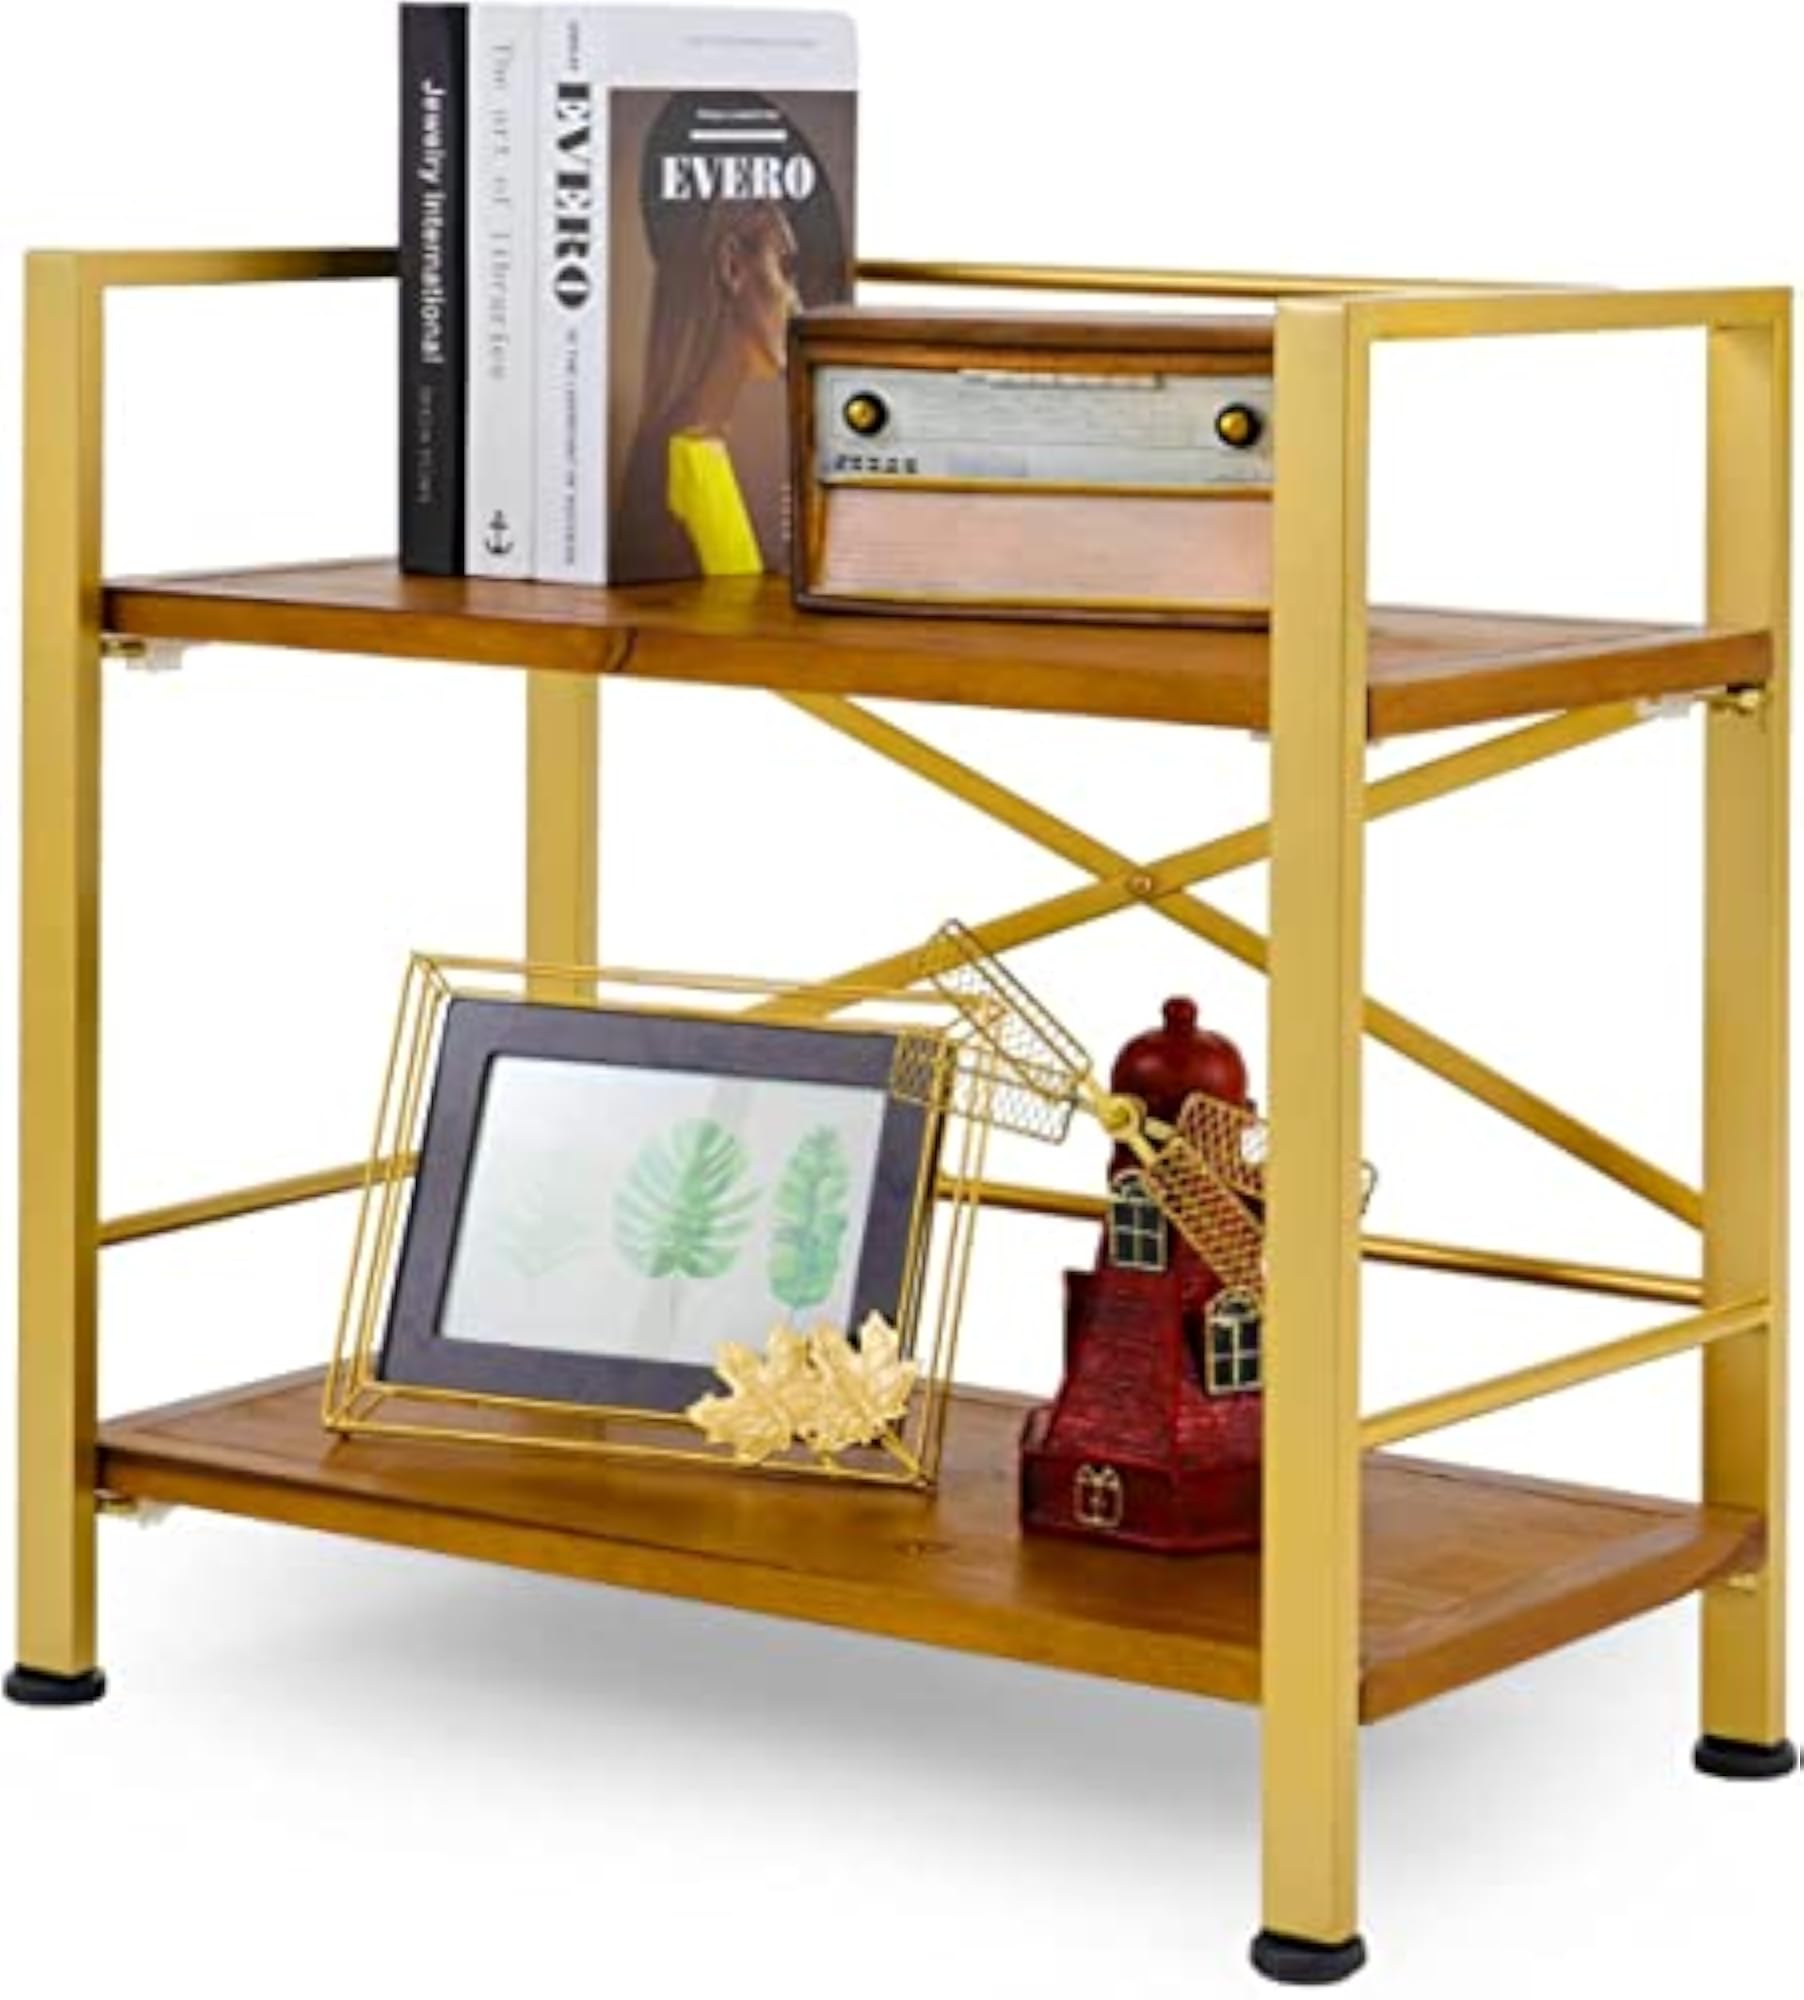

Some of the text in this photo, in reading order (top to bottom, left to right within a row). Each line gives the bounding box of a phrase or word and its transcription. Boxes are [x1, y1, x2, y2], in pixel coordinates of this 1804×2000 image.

[417, 78, 447, 183] Jewelry
[661, 154, 816, 201] EVERO
[490, 177, 512, 209] of
[555, 82, 591, 309] EVERO
[420, 192, 447, 364] International
